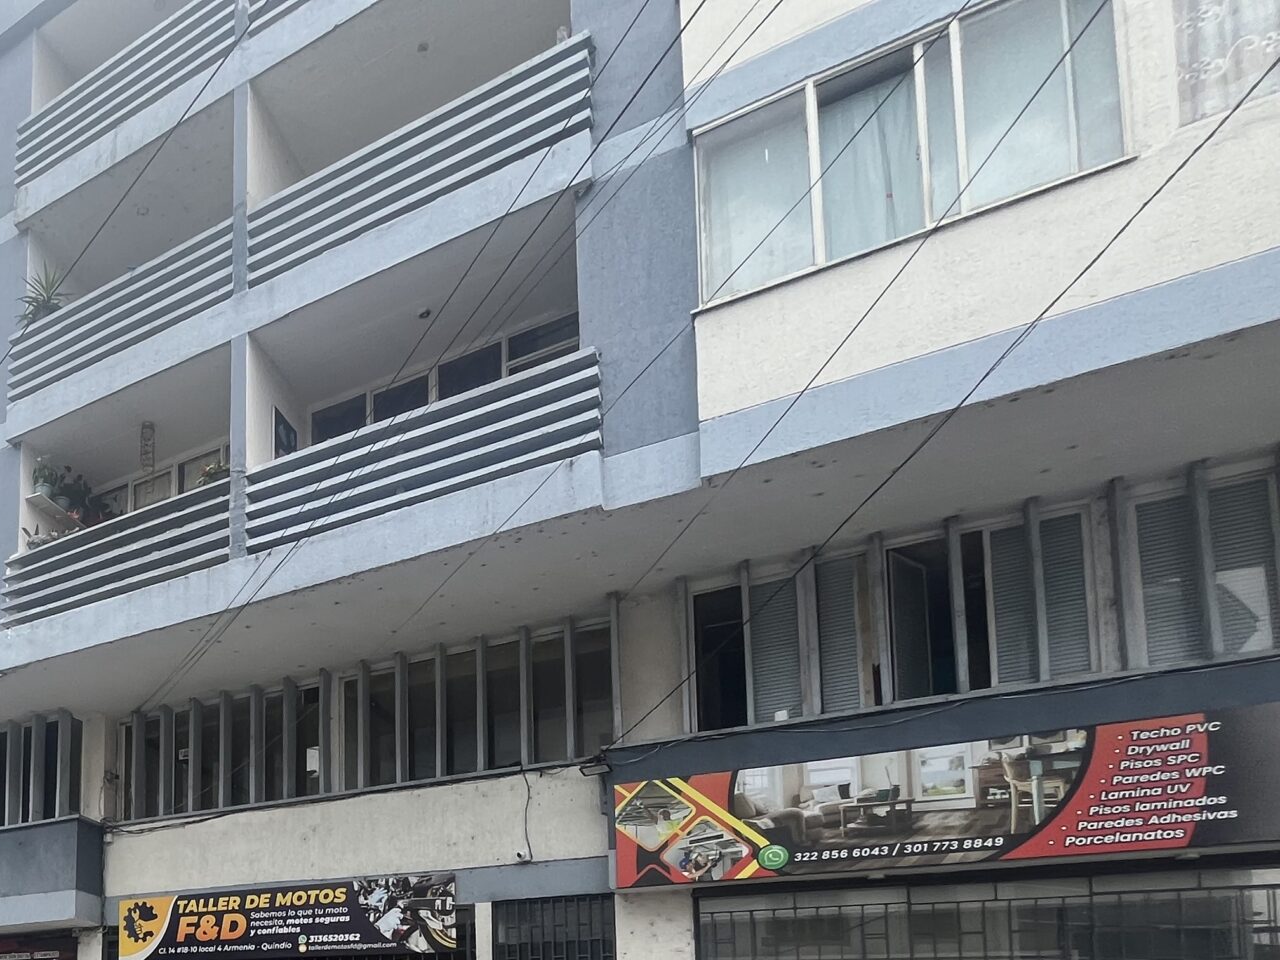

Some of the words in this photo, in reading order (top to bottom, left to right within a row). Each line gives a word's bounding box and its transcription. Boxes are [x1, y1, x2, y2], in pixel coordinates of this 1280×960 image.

[1131, 725, 1181, 741] Techo
[1186, 721, 1222, 734] PVC
[1127, 739, 1190, 756] Drywall
[1120, 757, 1162, 770] Pisos
[1167, 753, 1200, 765] SPC
[1112, 770, 1180, 785] Paredes
[1185, 765, 1226, 777] WPC
[1101, 785, 1162, 800] Lamina
[1167, 783, 1191, 794] UV
[1089, 803, 1131, 816] Pisos
[1135, 795, 1227, 812] laminados
[1078, 816, 1144, 831] Paredes
[1148, 809, 1238, 825] Adhesivas
[1065, 829, 1185, 847] Porcelanatos
[794, 851, 818, 862] 322
[821, 849, 848, 860] 856
[852, 845, 889, 858] 6043
[903, 842, 928, 854] 301
[932, 840, 959, 852] 773
[963, 836, 1004, 850] 8849
[177, 895, 241, 914] TALLER
[245, 893, 271, 909] DE
[275, 887, 347, 908] MOTOS
[250, 909, 286, 920] Sabemos
[288, 908, 296, 917] lo
[297, 908, 313, 919] que
[314, 906, 324, 915] tu
[325, 905, 348, 914] moto
[250, 917, 285, 928] necesita,
[286, 916, 313, 925] motos
[314, 914, 350, 925] seguras
[176, 913, 247, 943] F&D
[256, 925, 301, 936] confiables
[308, 933, 361, 943] 3136520362
[199, 945, 216, 953] local
[223, 943, 255, 952] Armenia
